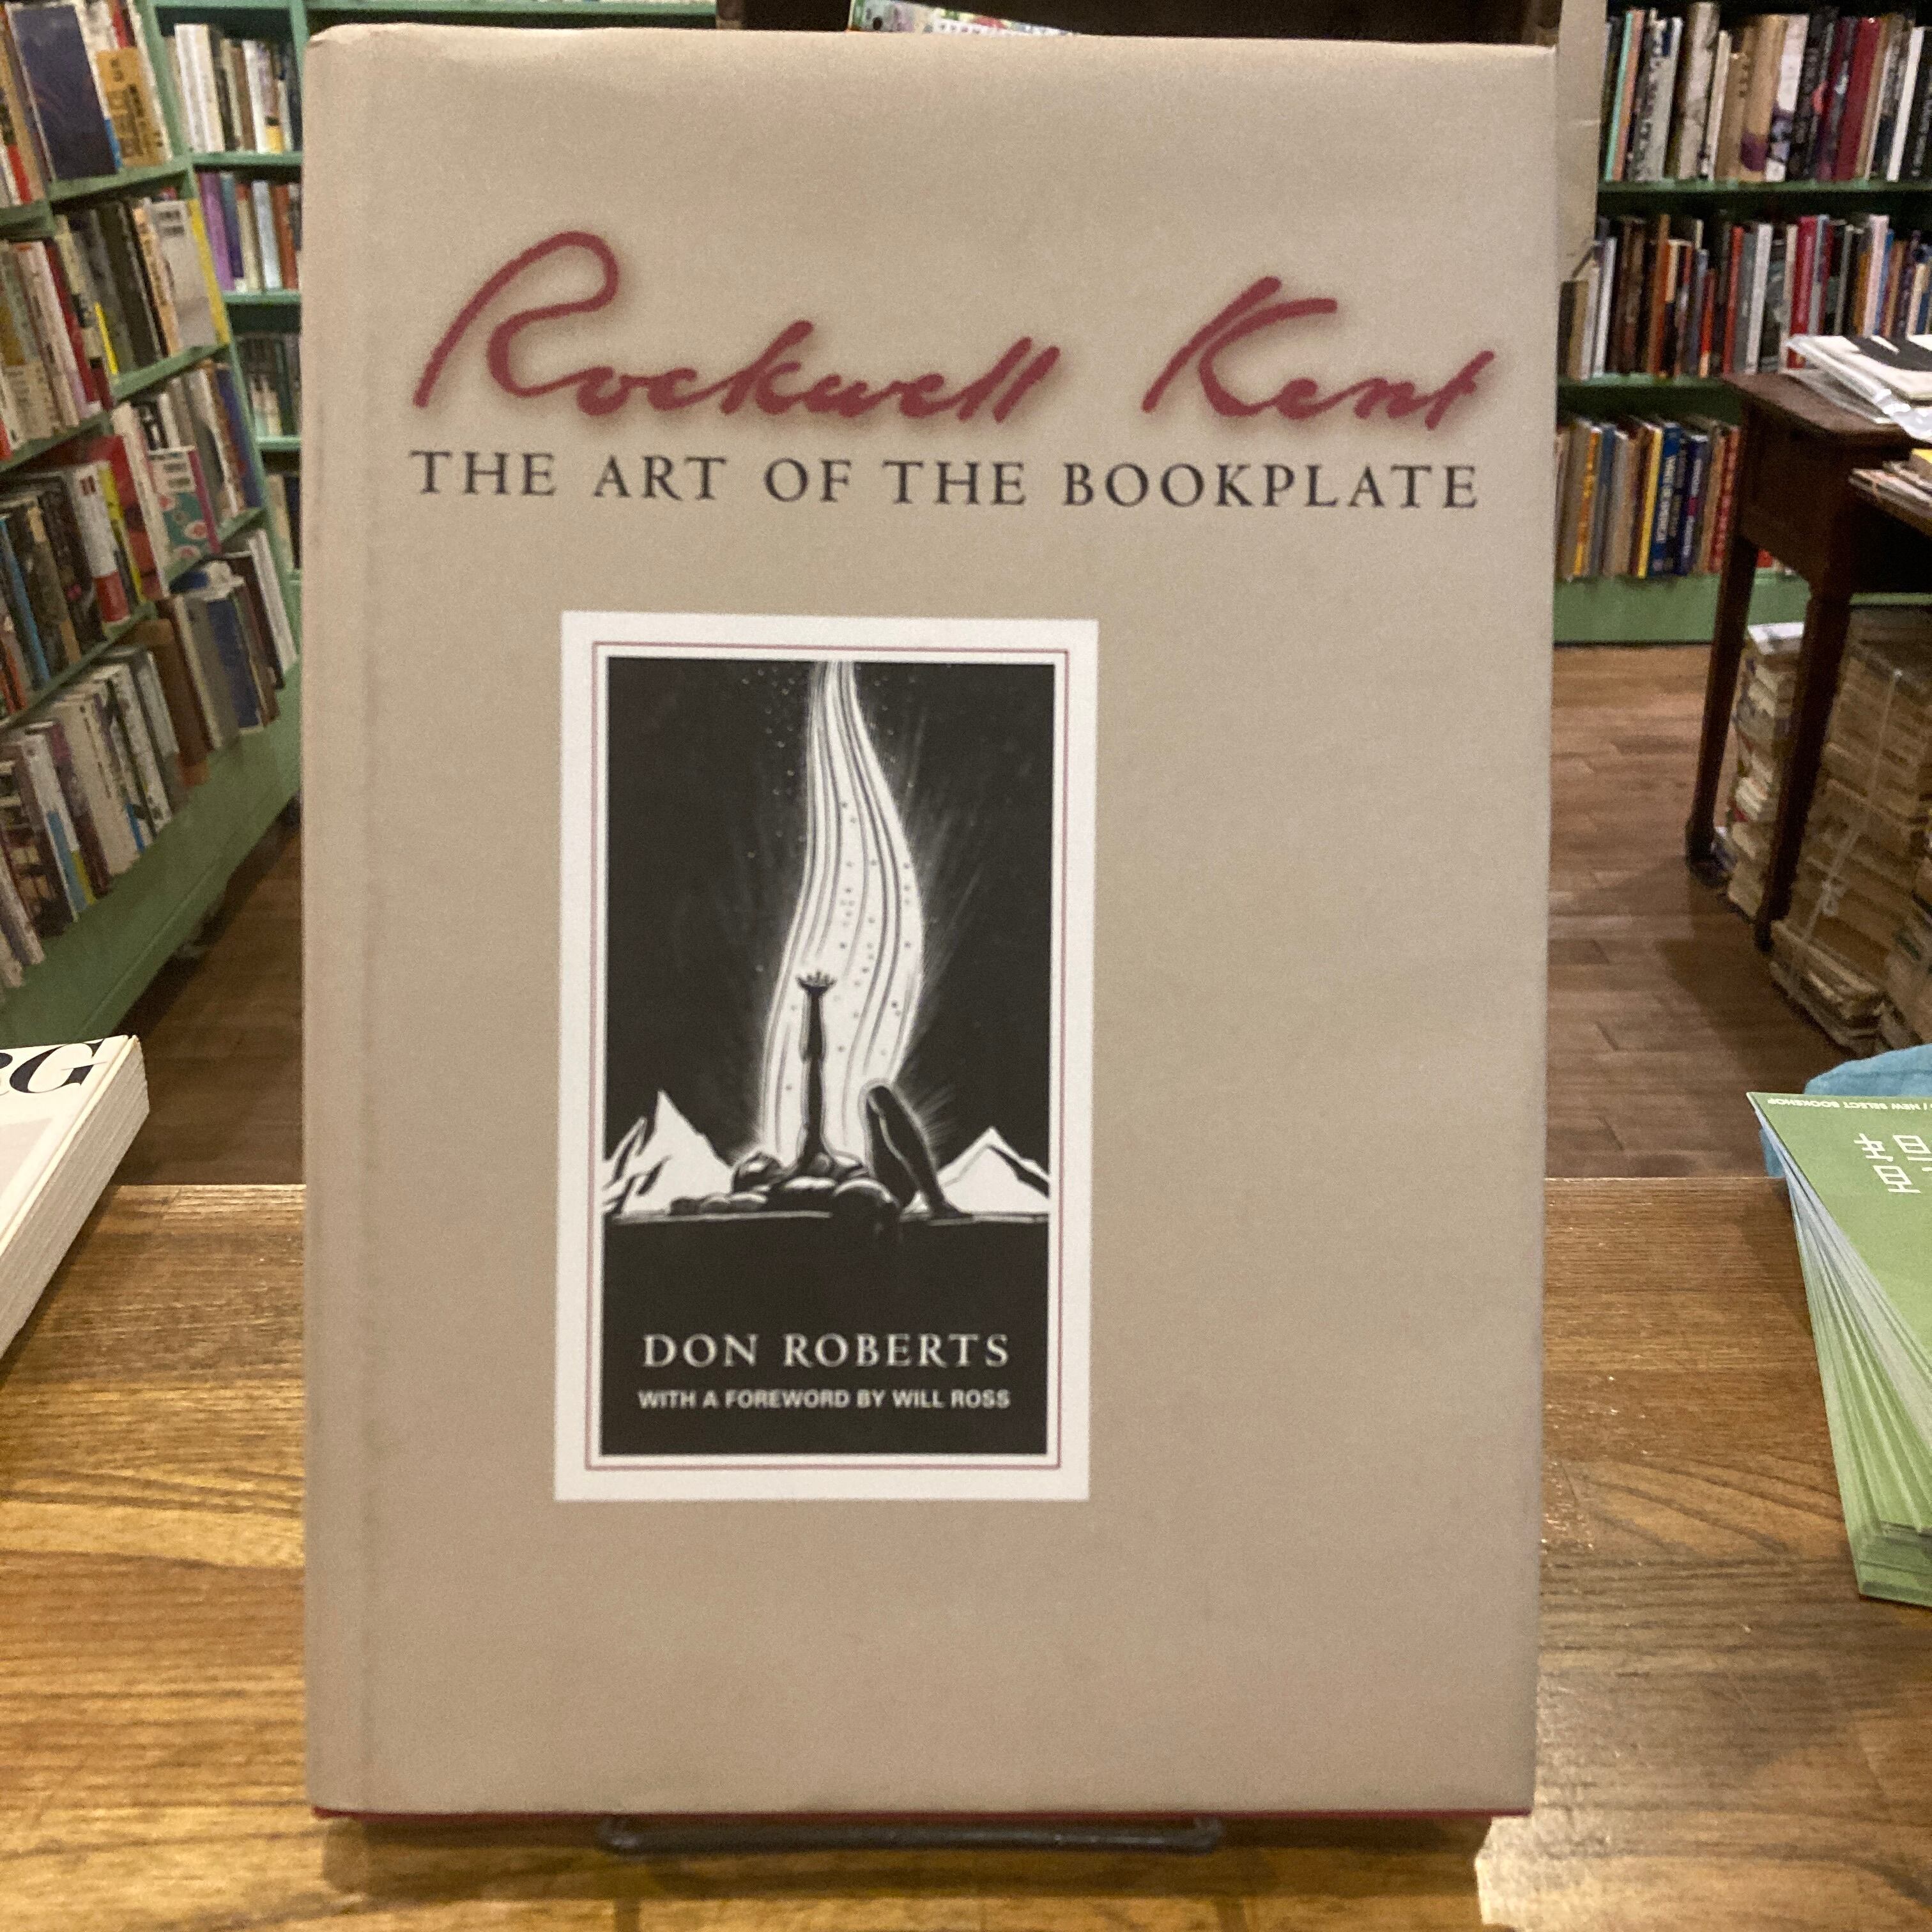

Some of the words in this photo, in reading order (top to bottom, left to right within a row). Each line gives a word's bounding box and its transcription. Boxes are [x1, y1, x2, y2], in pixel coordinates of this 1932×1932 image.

[413, 231, 1061, 423] Rockwell
[1141, 275, 1495, 430] Kent
[410, 450, 555, 496] THE
[593, 455, 727, 500] ART
[763, 457, 852, 502] OF
[882, 460, 1025, 506] THE
[1064, 463, 1478, 509] BOOKPLATE
[1767, 1098, 1841, 1108] BOOKSHOP
[1843, 1101, 1889, 1110] SELECT
[1853, 1133, 1922, 1193] 百年
[643, 1333, 758, 1368] DON
[783, 1333, 1009, 1368] ROBERTS
[638, 1389, 696, 1409] WITH
[702, 1390, 719, 1409] A
[724, 1389, 850, 1409] FOREWORD
[856, 1389, 886, 1409] BY
[892, 1389, 943, 1409] WILL
[951, 1389, 1011, 1409] ROSS
